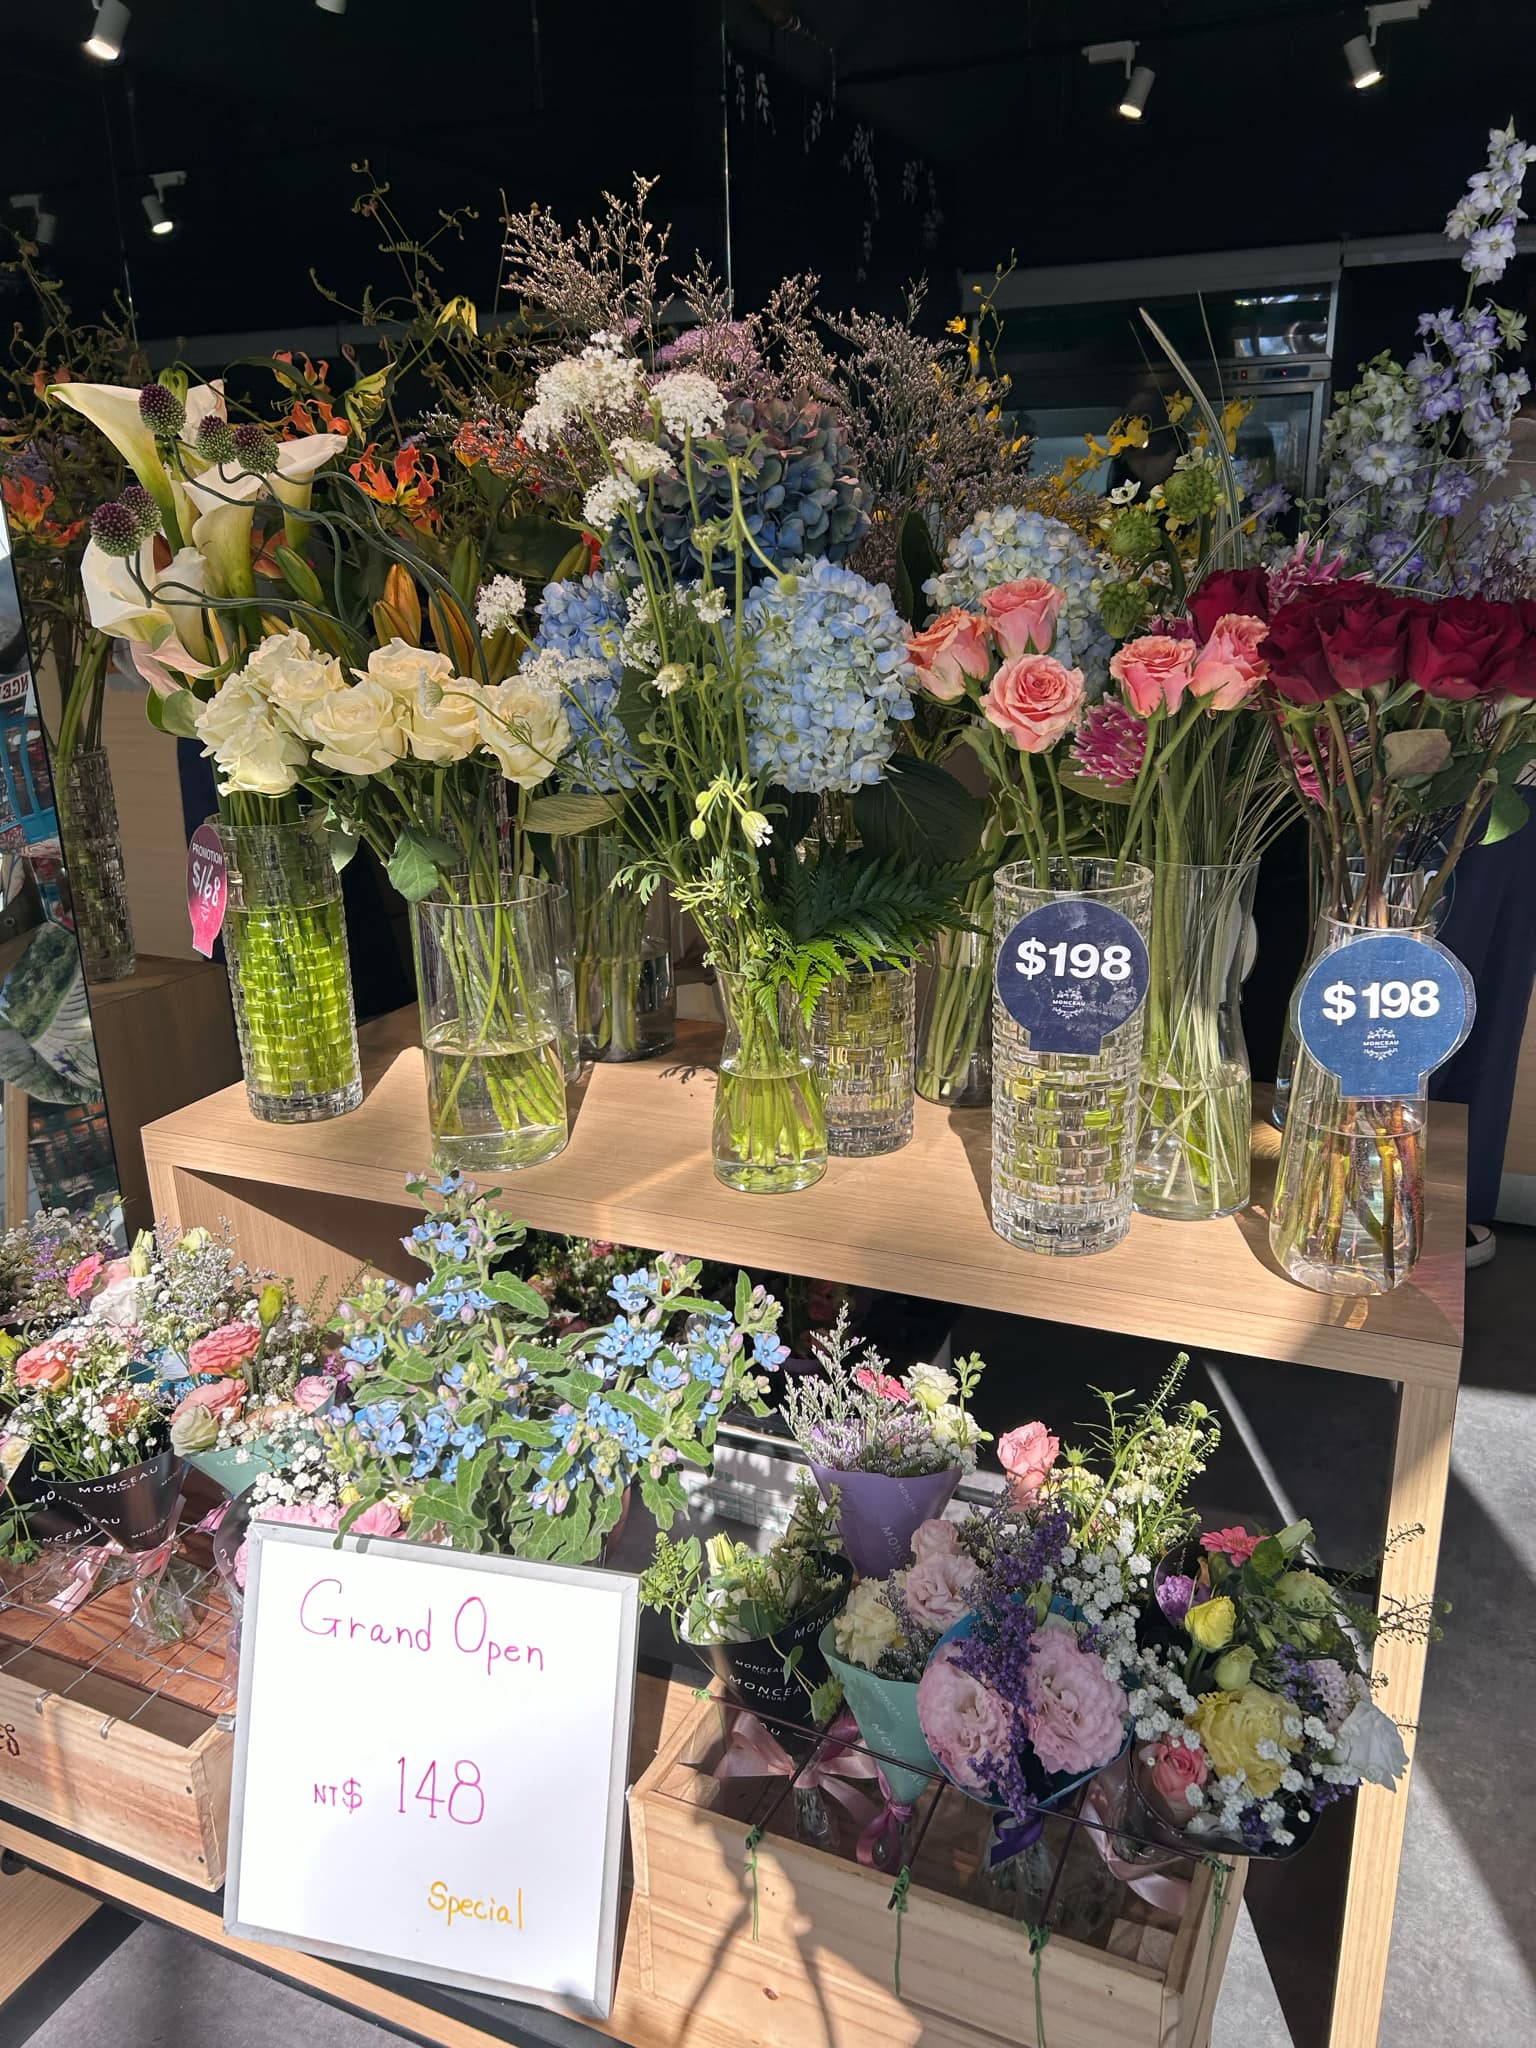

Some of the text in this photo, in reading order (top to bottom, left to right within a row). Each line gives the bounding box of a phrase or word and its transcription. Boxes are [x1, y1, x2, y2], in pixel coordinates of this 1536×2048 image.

[192, 842, 223, 865] PROMOTION
[192, 860, 221, 907] $168
[1015, 937, 1132, 981] $198
[1322, 980, 1440, 1026] $198
[78, 1465, 159, 1494] MONCEAU
[300, 1578, 544, 1676] Grand Open
[314, 1756, 485, 1825] NT$ 148
[427, 1880, 523, 1930] Special
